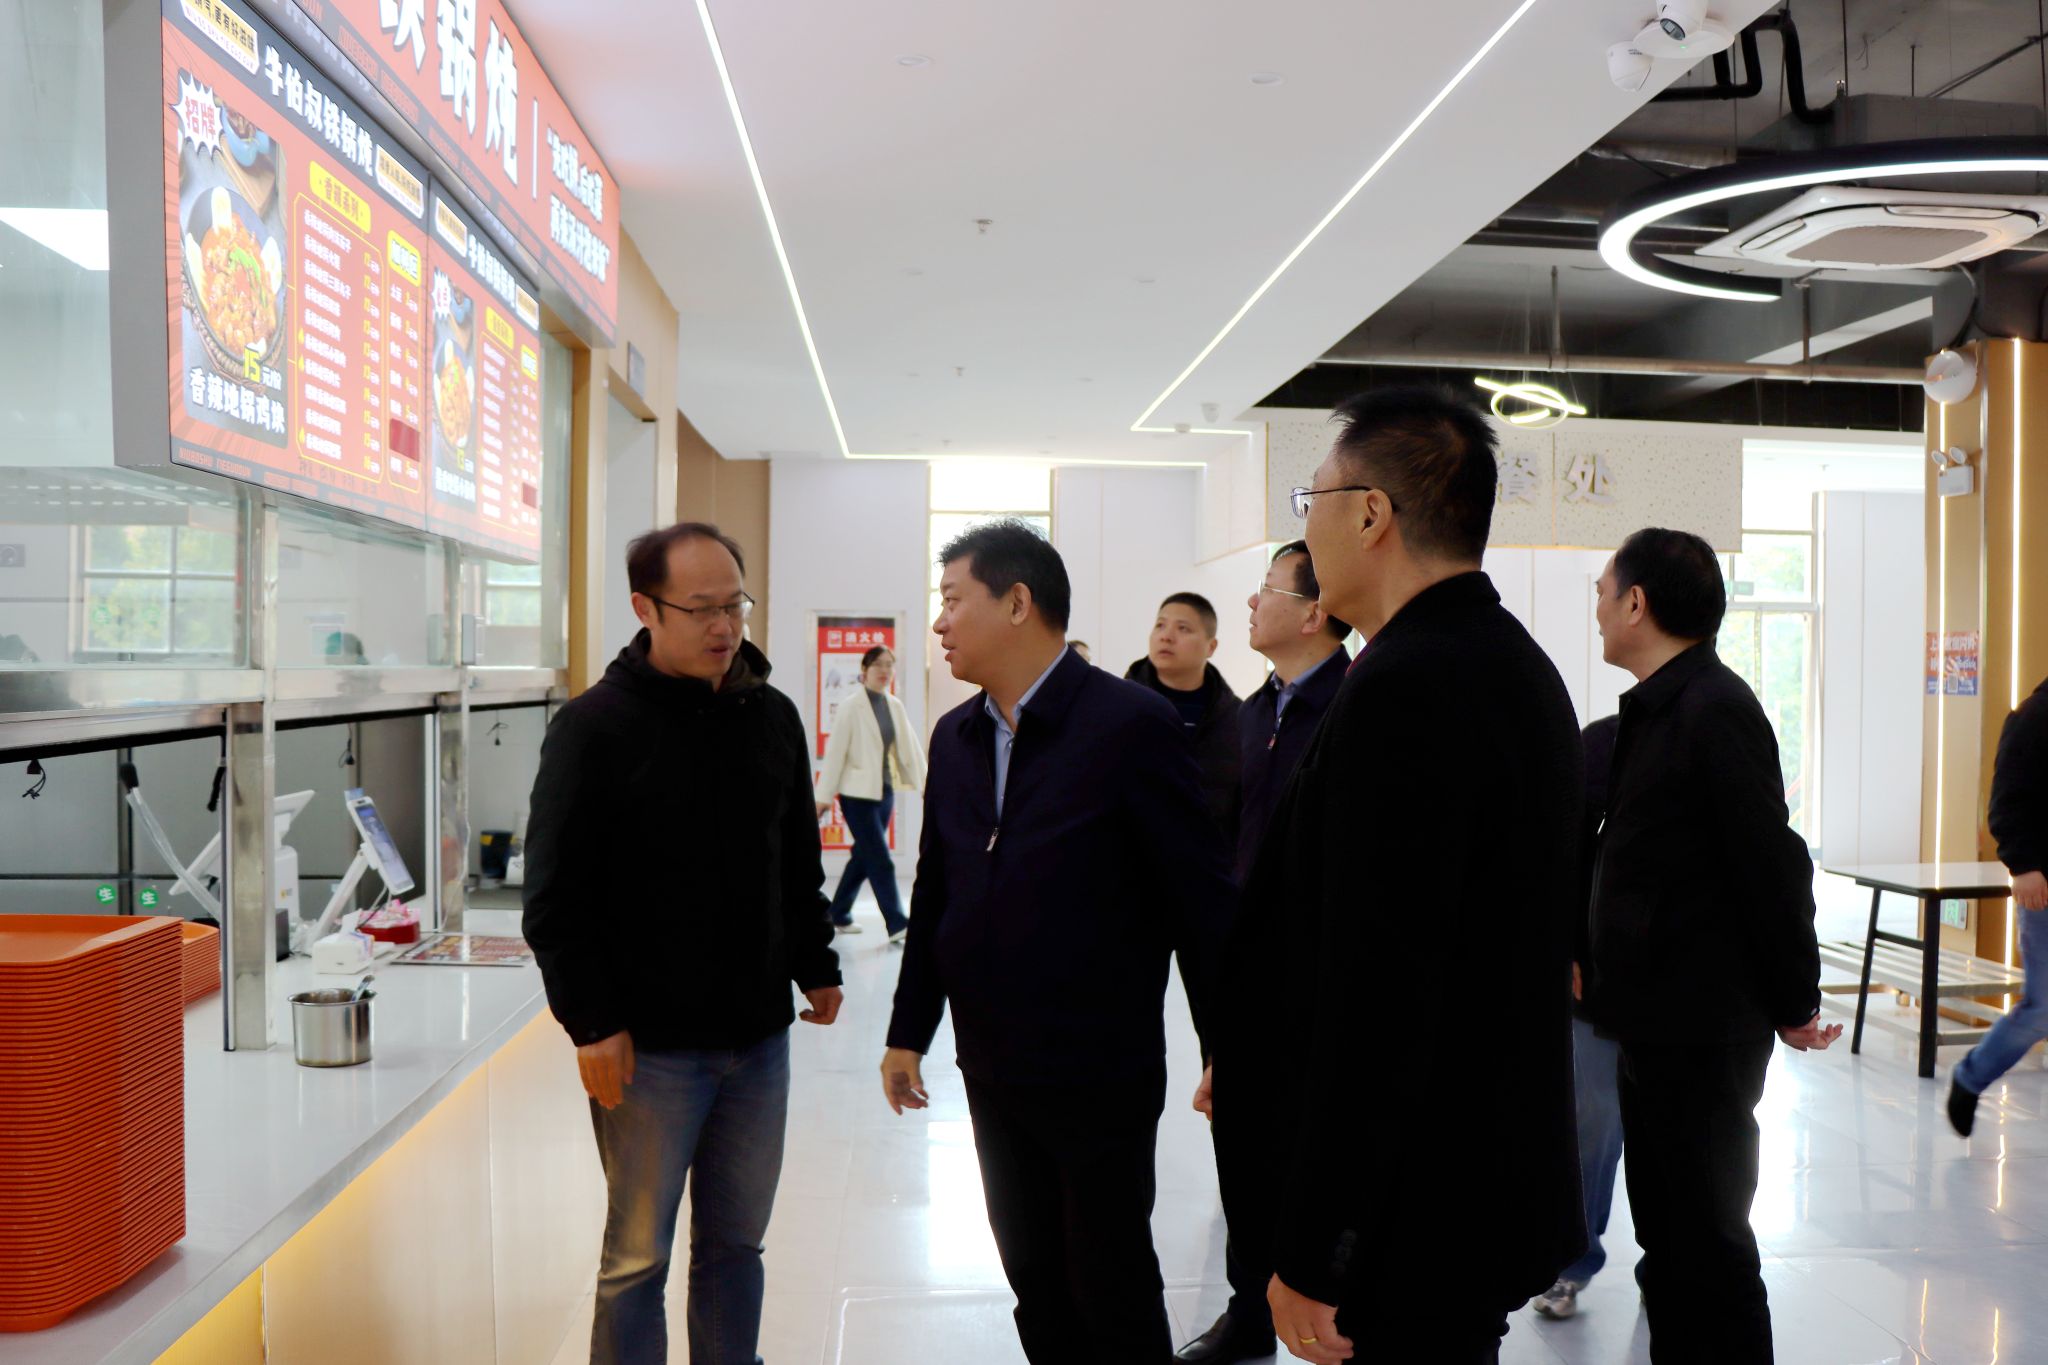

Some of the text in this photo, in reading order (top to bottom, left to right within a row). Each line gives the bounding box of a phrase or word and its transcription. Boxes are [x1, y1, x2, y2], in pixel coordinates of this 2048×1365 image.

[184, 95, 217, 141] 招牌
[190, 367, 286, 434] 香辣地锅鸡块
